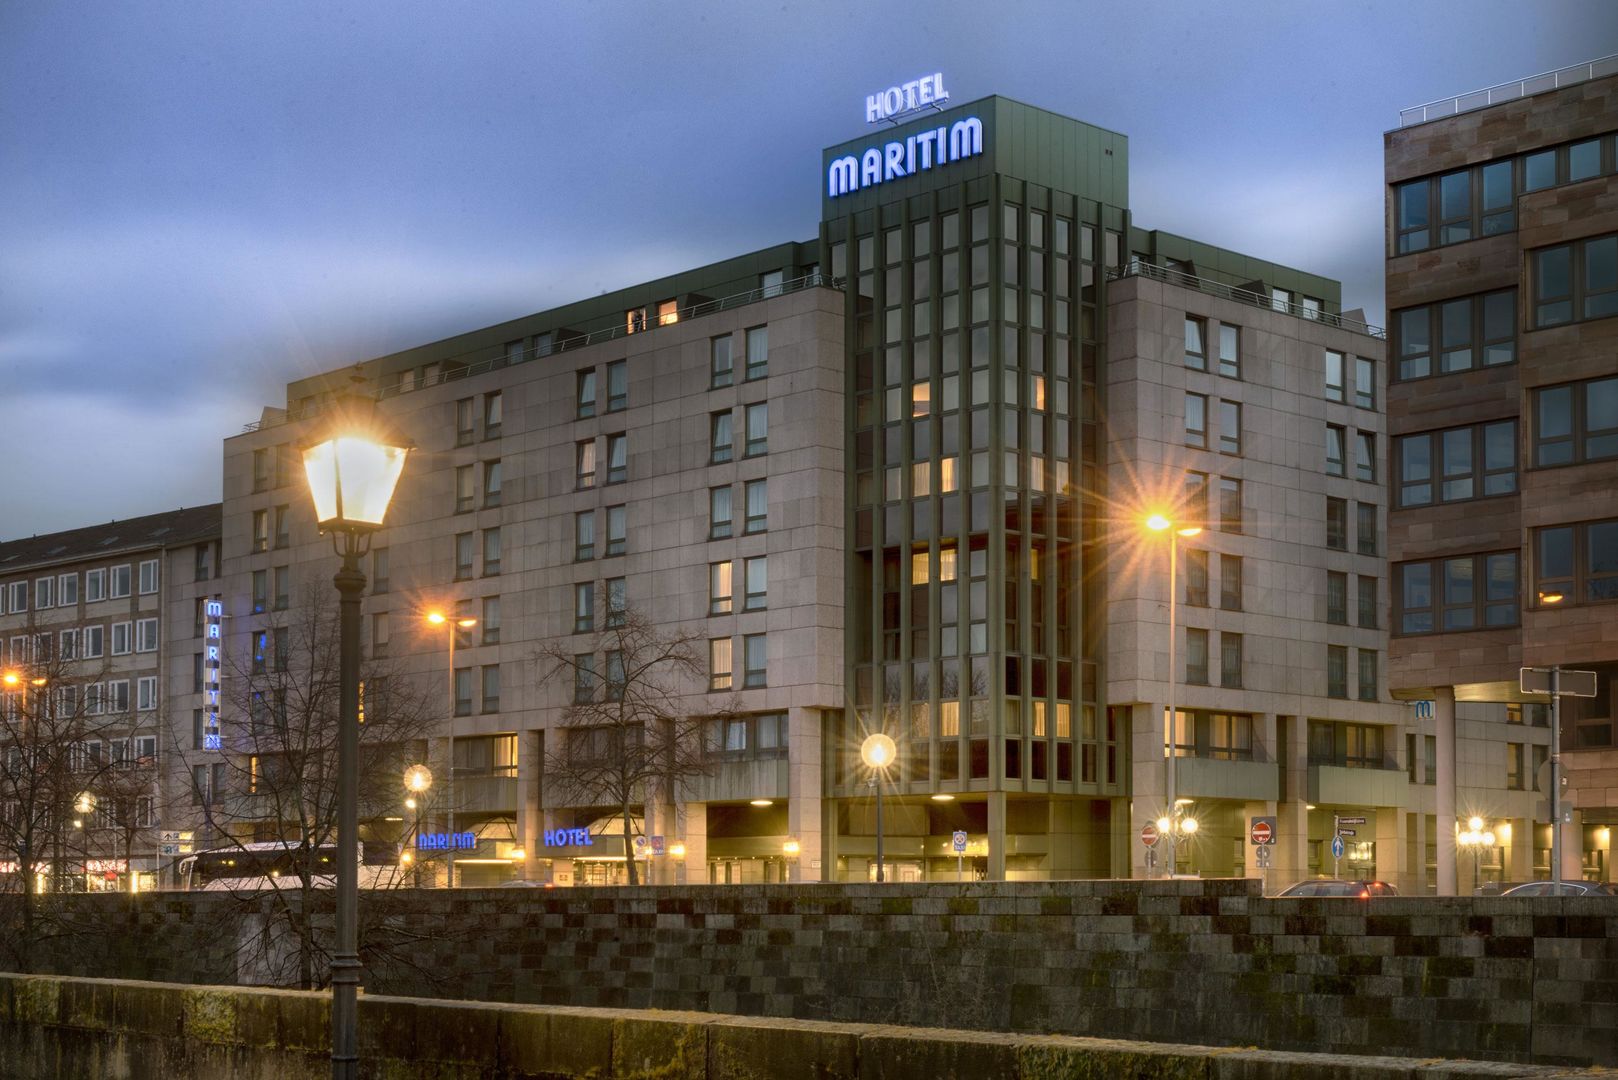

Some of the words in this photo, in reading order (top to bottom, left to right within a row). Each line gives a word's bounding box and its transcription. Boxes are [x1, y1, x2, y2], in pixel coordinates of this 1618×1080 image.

[866, 72, 949, 123] HOTEL
[829, 116, 983, 198] MARITIM
[205, 602, 222, 750] MARITIM
[544, 828, 593, 847] HOTEL
